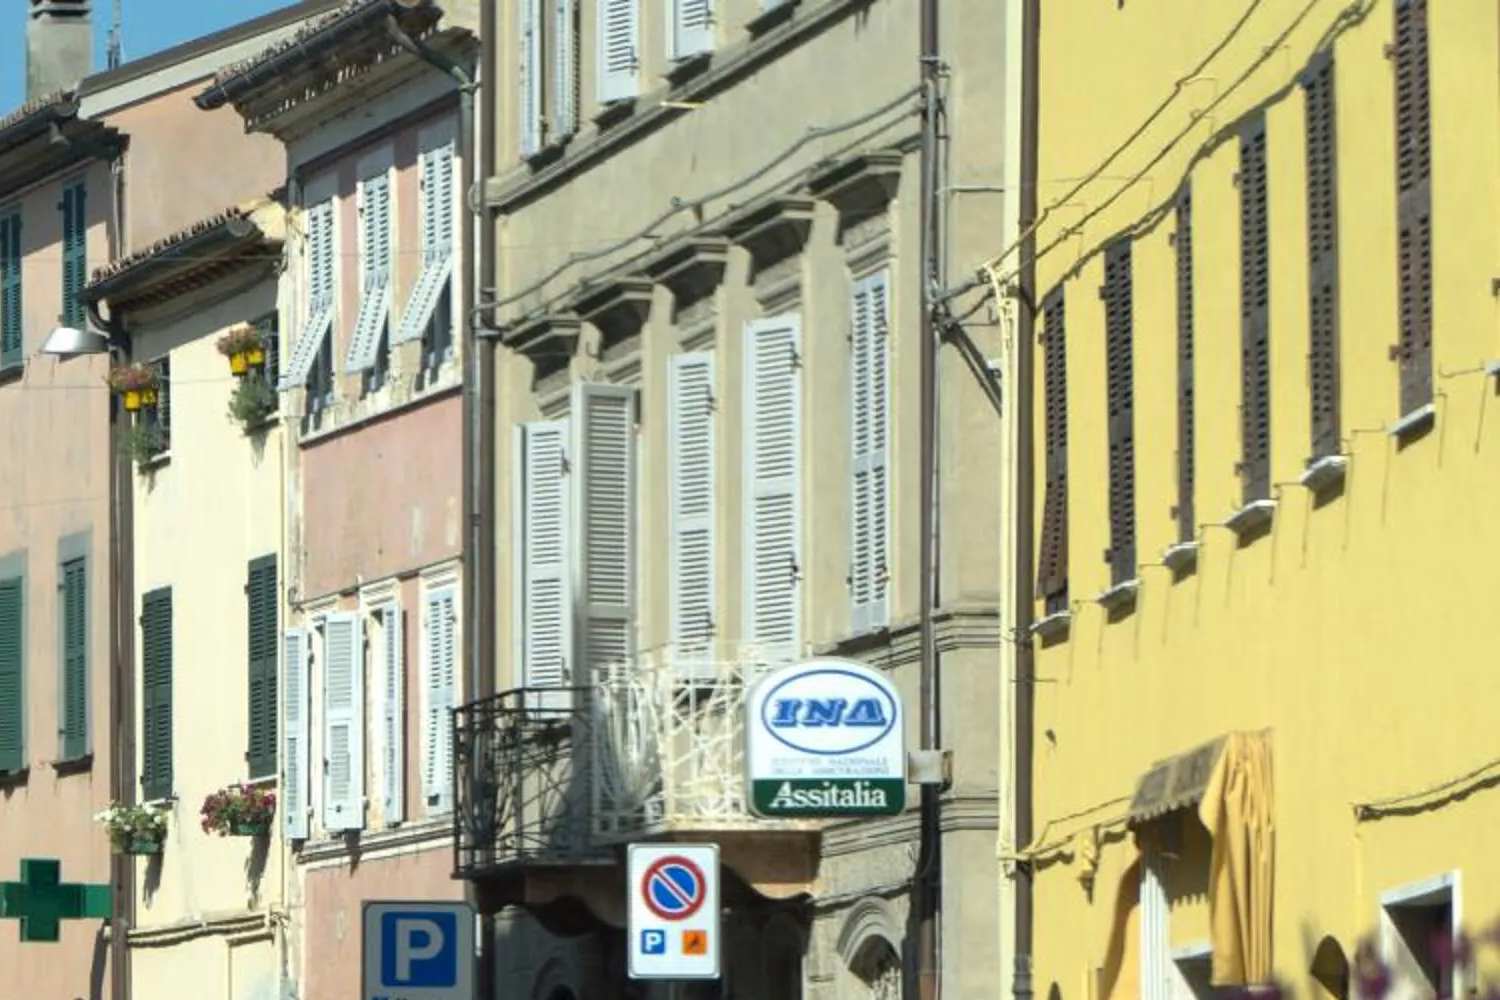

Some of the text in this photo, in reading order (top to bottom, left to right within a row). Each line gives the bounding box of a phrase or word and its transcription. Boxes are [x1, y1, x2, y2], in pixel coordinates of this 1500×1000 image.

[772, 698, 887, 727] INA
[768, 781, 888, 808] Assitalia
[394, 918, 445, 981] P
[644, 931, 662, 952] P
